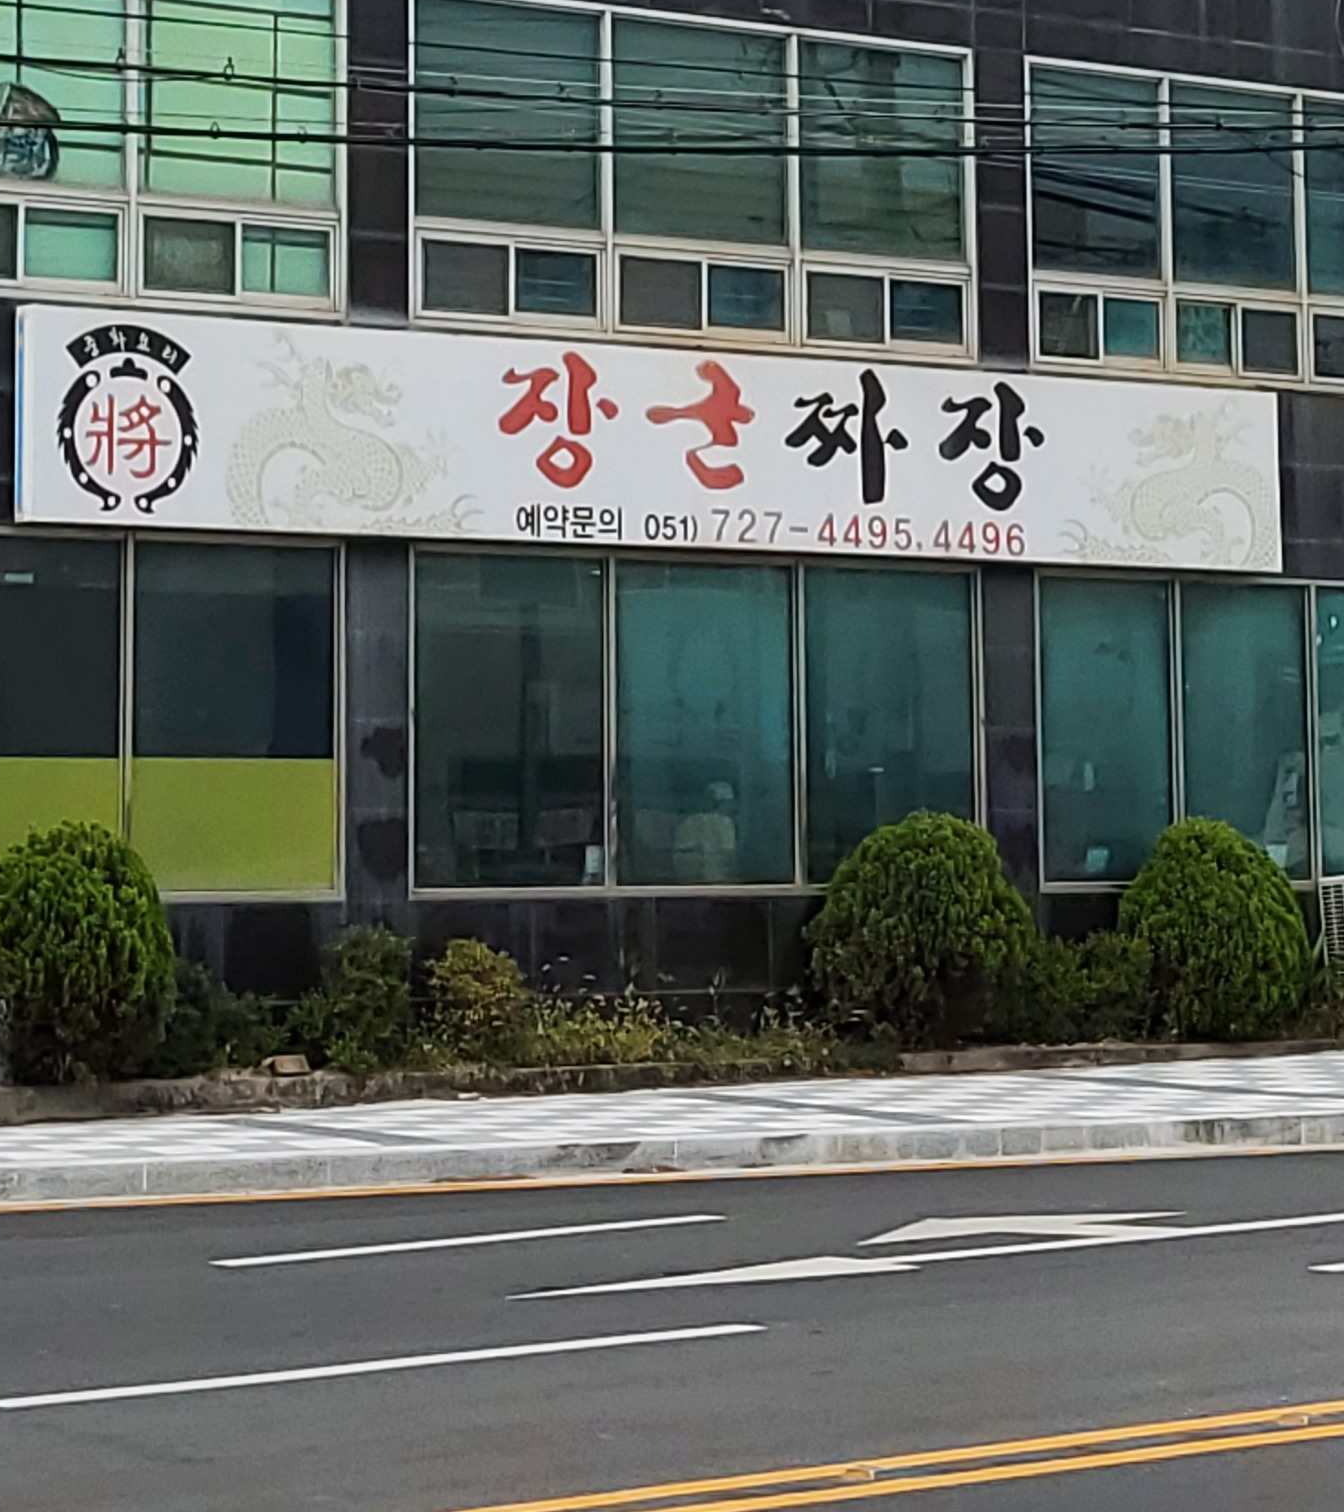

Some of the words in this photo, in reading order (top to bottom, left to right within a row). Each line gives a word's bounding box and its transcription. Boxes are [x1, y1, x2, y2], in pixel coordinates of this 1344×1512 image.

[83, 326, 179, 365] 중화요리
[85, 392, 173, 480] 將
[516, 503, 624, 541] 예약문의
[644, 513, 698, 543] 051)
